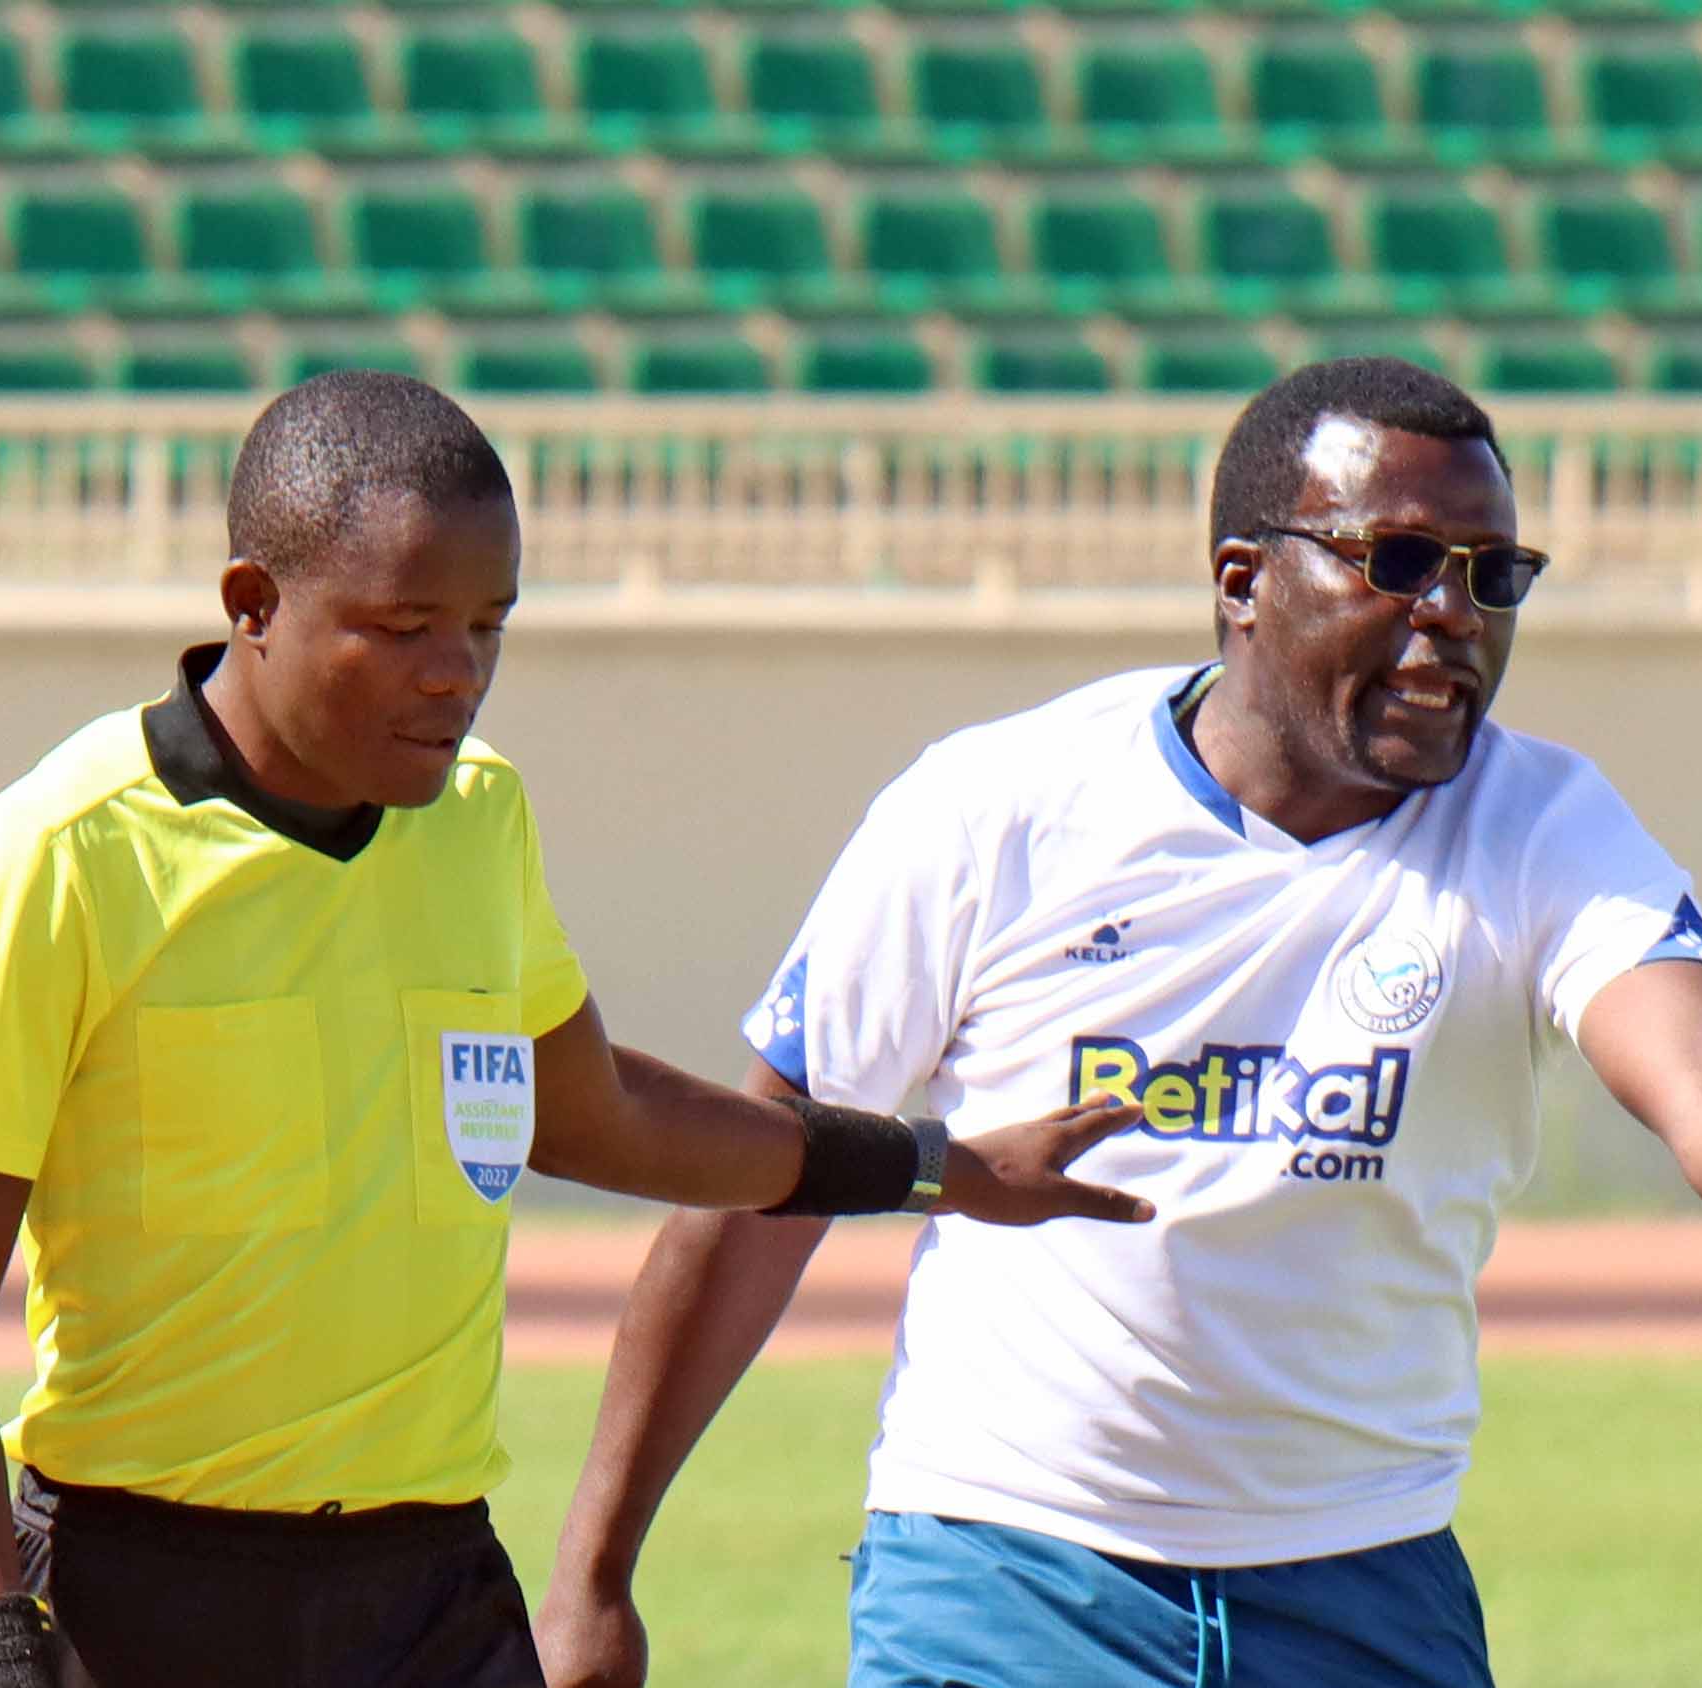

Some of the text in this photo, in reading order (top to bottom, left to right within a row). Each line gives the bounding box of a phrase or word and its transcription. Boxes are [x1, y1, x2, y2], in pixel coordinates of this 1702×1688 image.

[1064, 944, 1129, 963] KELM
[451, 1043, 525, 1085] FIFA
[477, 1168, 508, 1186] 2022
[1280, 1152, 1384, 1181] .com
